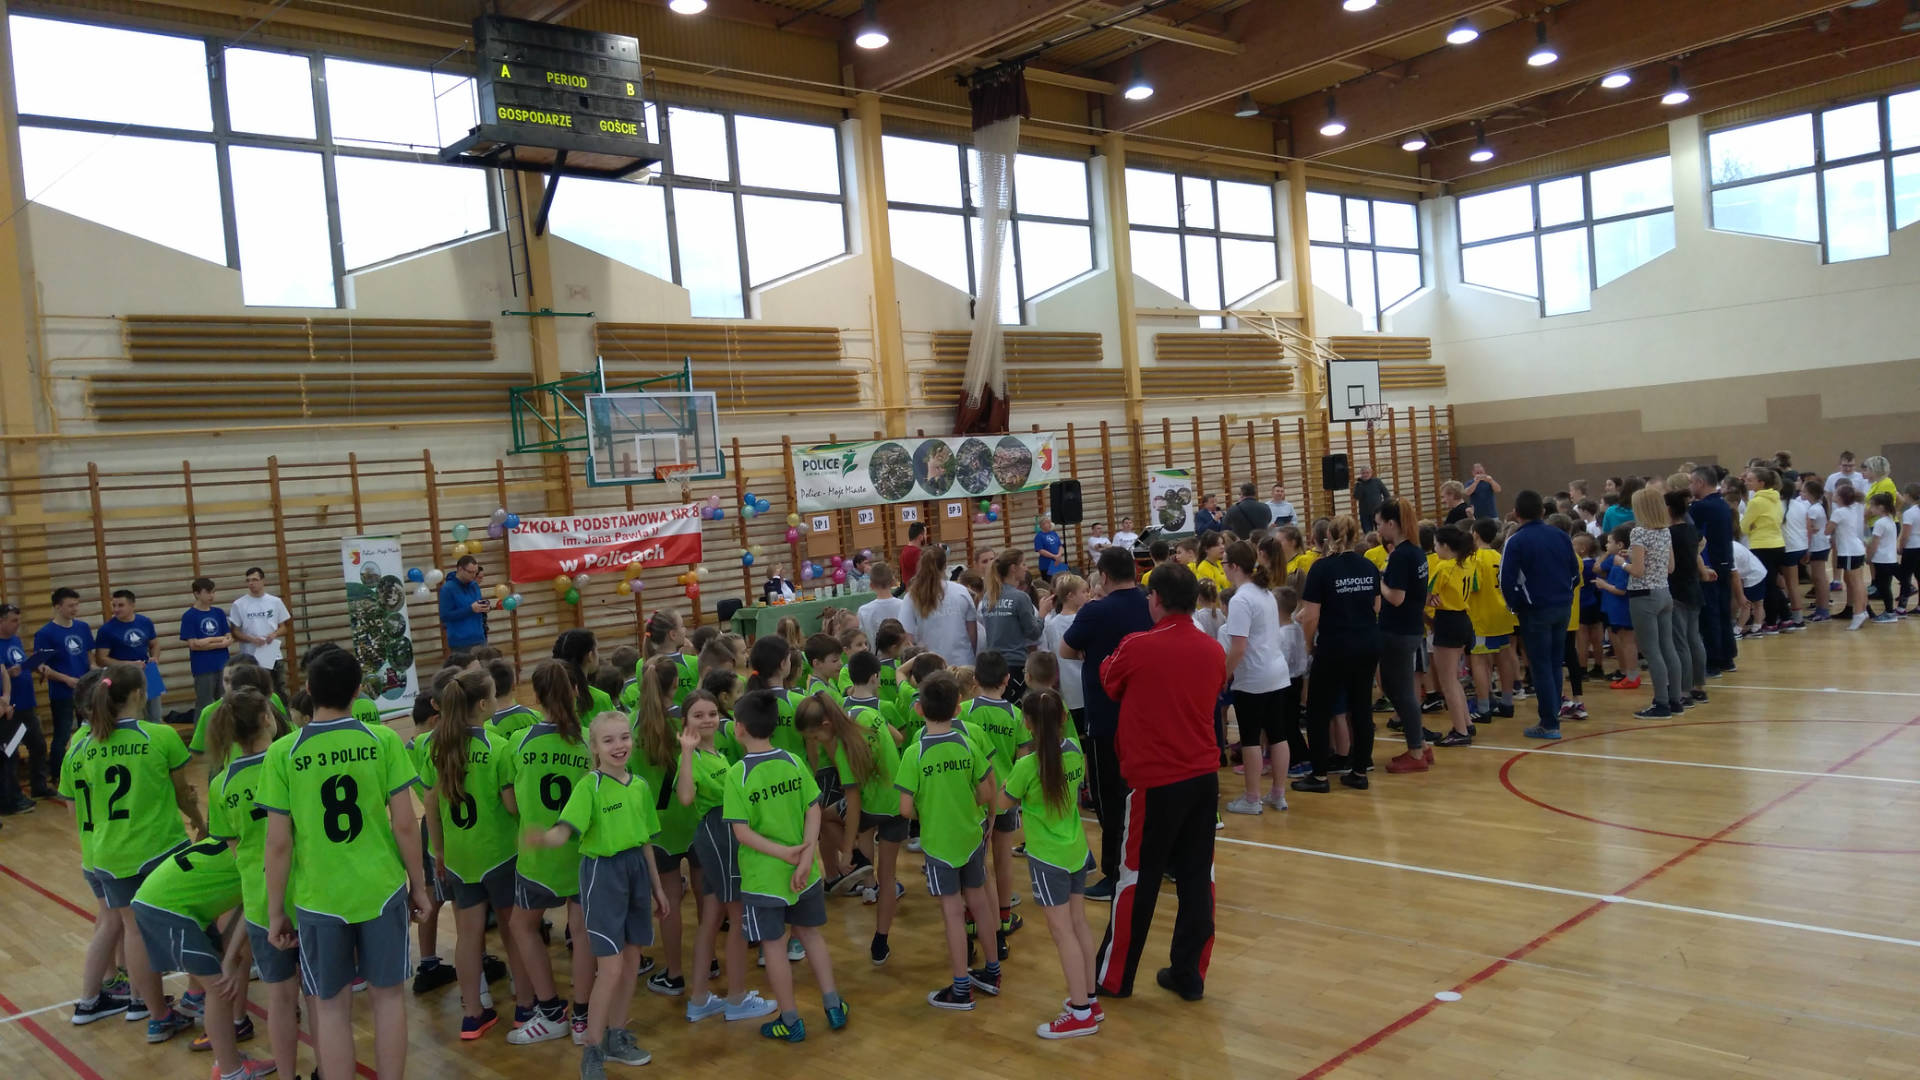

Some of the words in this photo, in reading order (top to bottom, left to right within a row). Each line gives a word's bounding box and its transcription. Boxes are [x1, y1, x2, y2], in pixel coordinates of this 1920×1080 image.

[501, 64, 511, 79] A
[546, 71, 588, 88] PERIOD
[626, 83, 635, 96] B
[498, 107, 572, 128] GOSPODARZE
[600, 119, 637, 135] GOŚCIE
[803, 458, 839, 471] POLICE
[800, 488, 820, 499] Police
[859, 513, 867, 523] SP
[903, 511, 910, 519] SP
[949, 506, 956, 515] SP
[512, 520, 569, 535] SZKOŁA
[574, 511, 669, 532] PODSTAWOWA
[672, 508, 689, 521] NR
[692, 505, 700, 518] 8
[814, 520, 823, 530] SP
[563, 536, 581, 547] im.
[584, 534, 611, 545] Jana
[559, 558, 578, 573] w
[583, 543, 665, 569] Policach
[678, 678, 691, 688] ICE
[989, 724, 1014, 737] POLICE
[86, 748, 97, 761] SP
[101, 746, 108, 758] 3
[111, 743, 149, 757] POLICE
[295, 755, 312, 771] SP
[318, 752, 328, 766] 3
[332, 746, 377, 764] POLICE
[72, 762, 82, 773] SP
[523, 752, 537, 765] SP
[541, 752, 548, 764] 3
[552, 753, 589, 769] POLICE
[923, 765, 934, 777] SP
[943, 758, 971, 772] POLICE
[1065, 767, 1083, 783] POLIC
[104, 764, 132, 821] 2
[226, 793, 240, 809] SP
[244, 788, 254, 801] 3
[749, 792, 760, 805] SP
[761, 788, 768, 800] 3
[320, 773, 363, 845] 8
